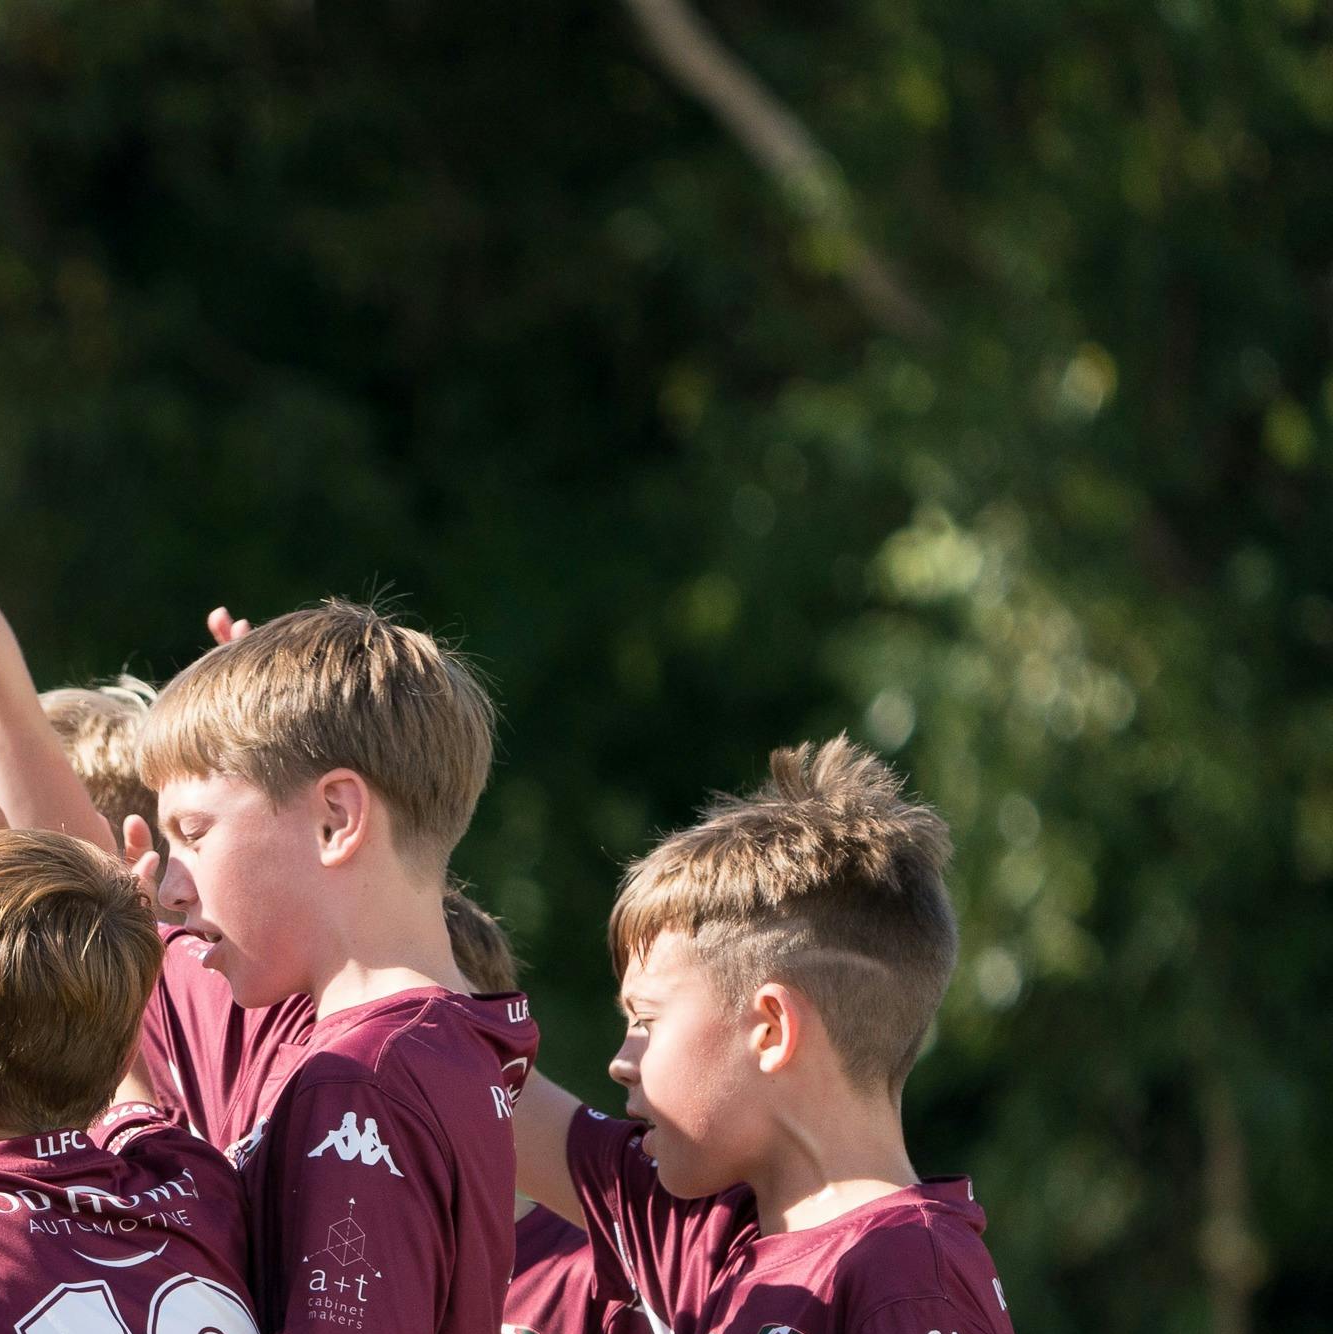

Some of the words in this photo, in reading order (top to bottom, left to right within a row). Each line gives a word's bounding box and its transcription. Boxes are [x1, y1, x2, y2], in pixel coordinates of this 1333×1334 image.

[506, 999, 530, 1024] LLF
[35, 1130, 87, 1158] LLFC
[308, 1296, 365, 1318] cabinet
[308, 1310, 363, 1330] makers
